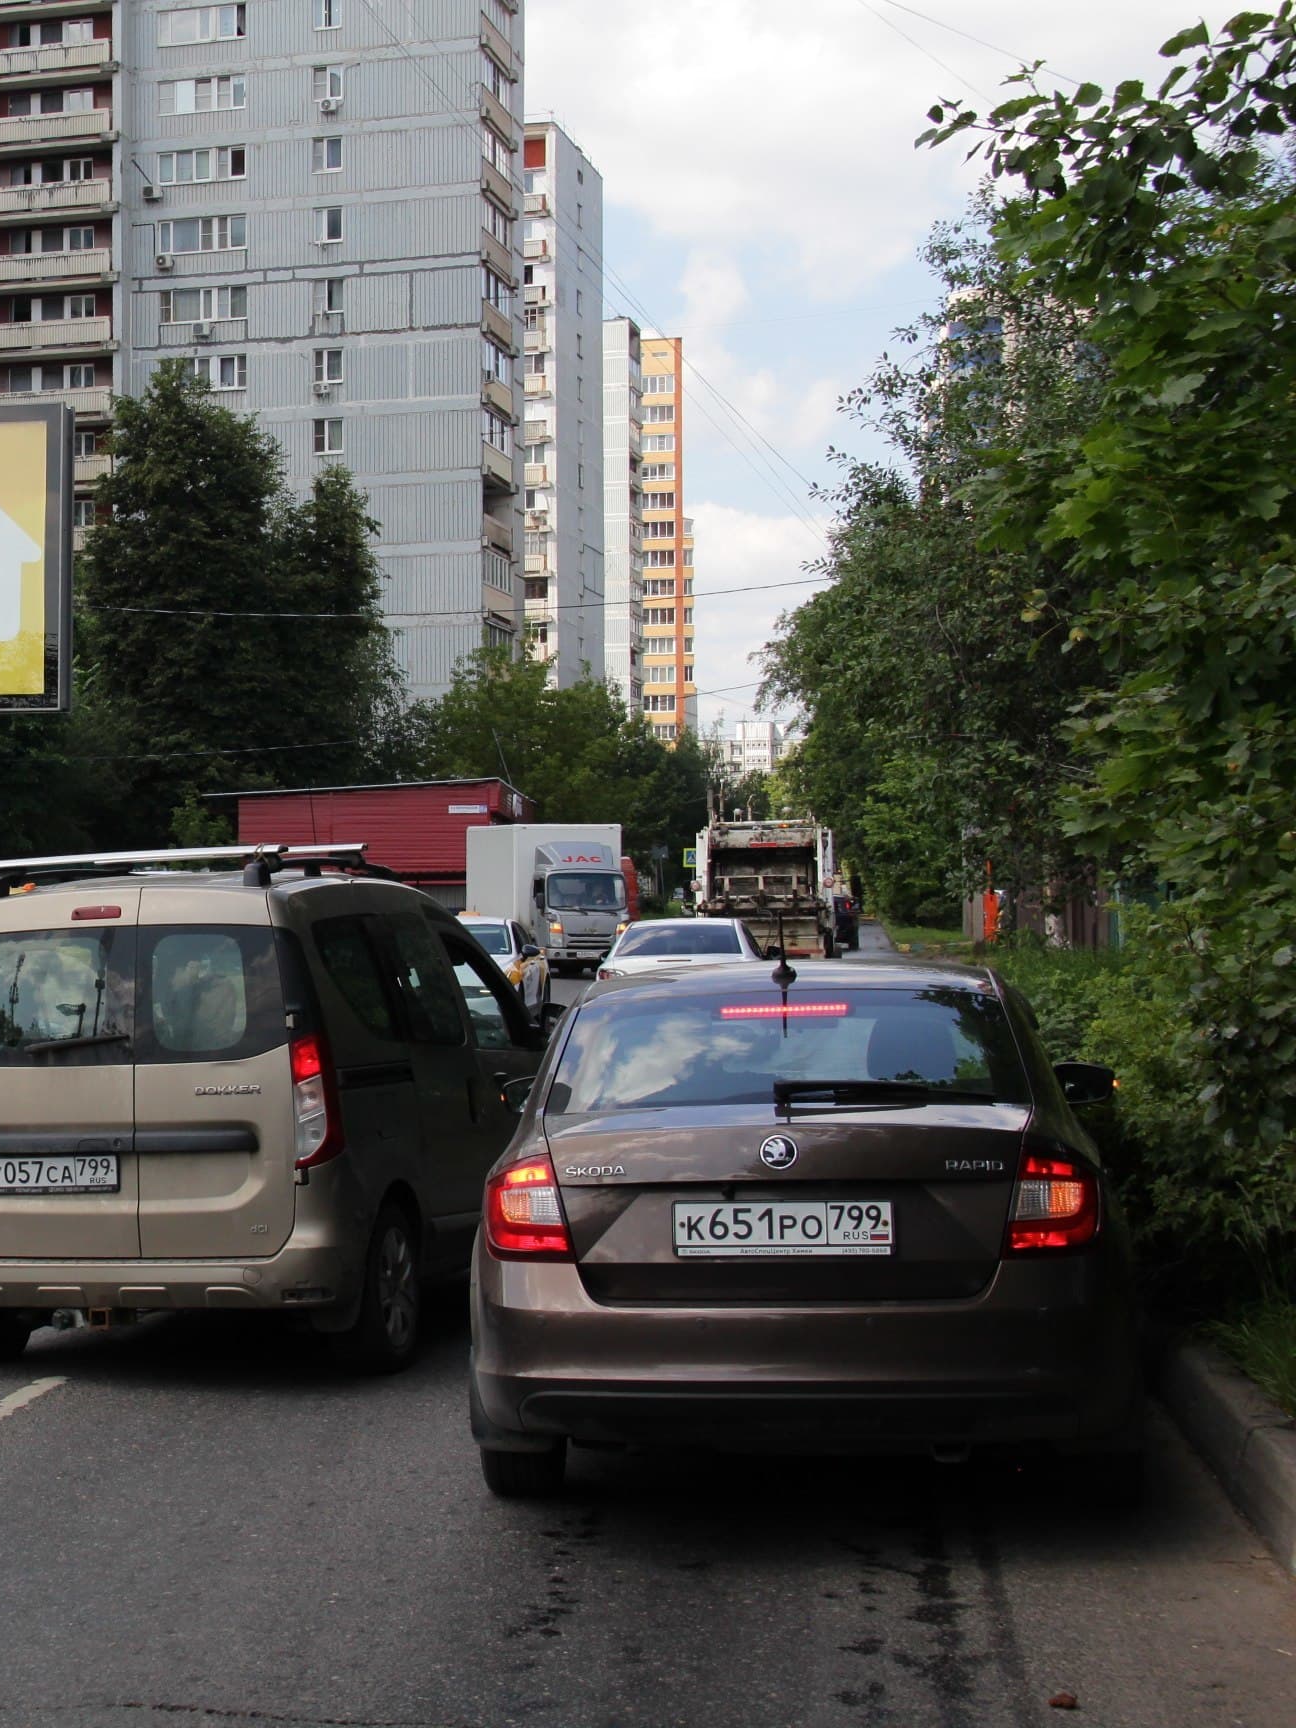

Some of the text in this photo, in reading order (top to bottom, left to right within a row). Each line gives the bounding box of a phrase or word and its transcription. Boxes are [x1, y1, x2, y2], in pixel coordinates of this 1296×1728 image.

[194, 1084, 262, 1096] DOKKER
[76, 1158, 112, 1176] 799
[945, 1159, 1004, 1171] RAPID
[829, 1205, 882, 1231] 799
[843, 1231, 869, 1240] RUS
